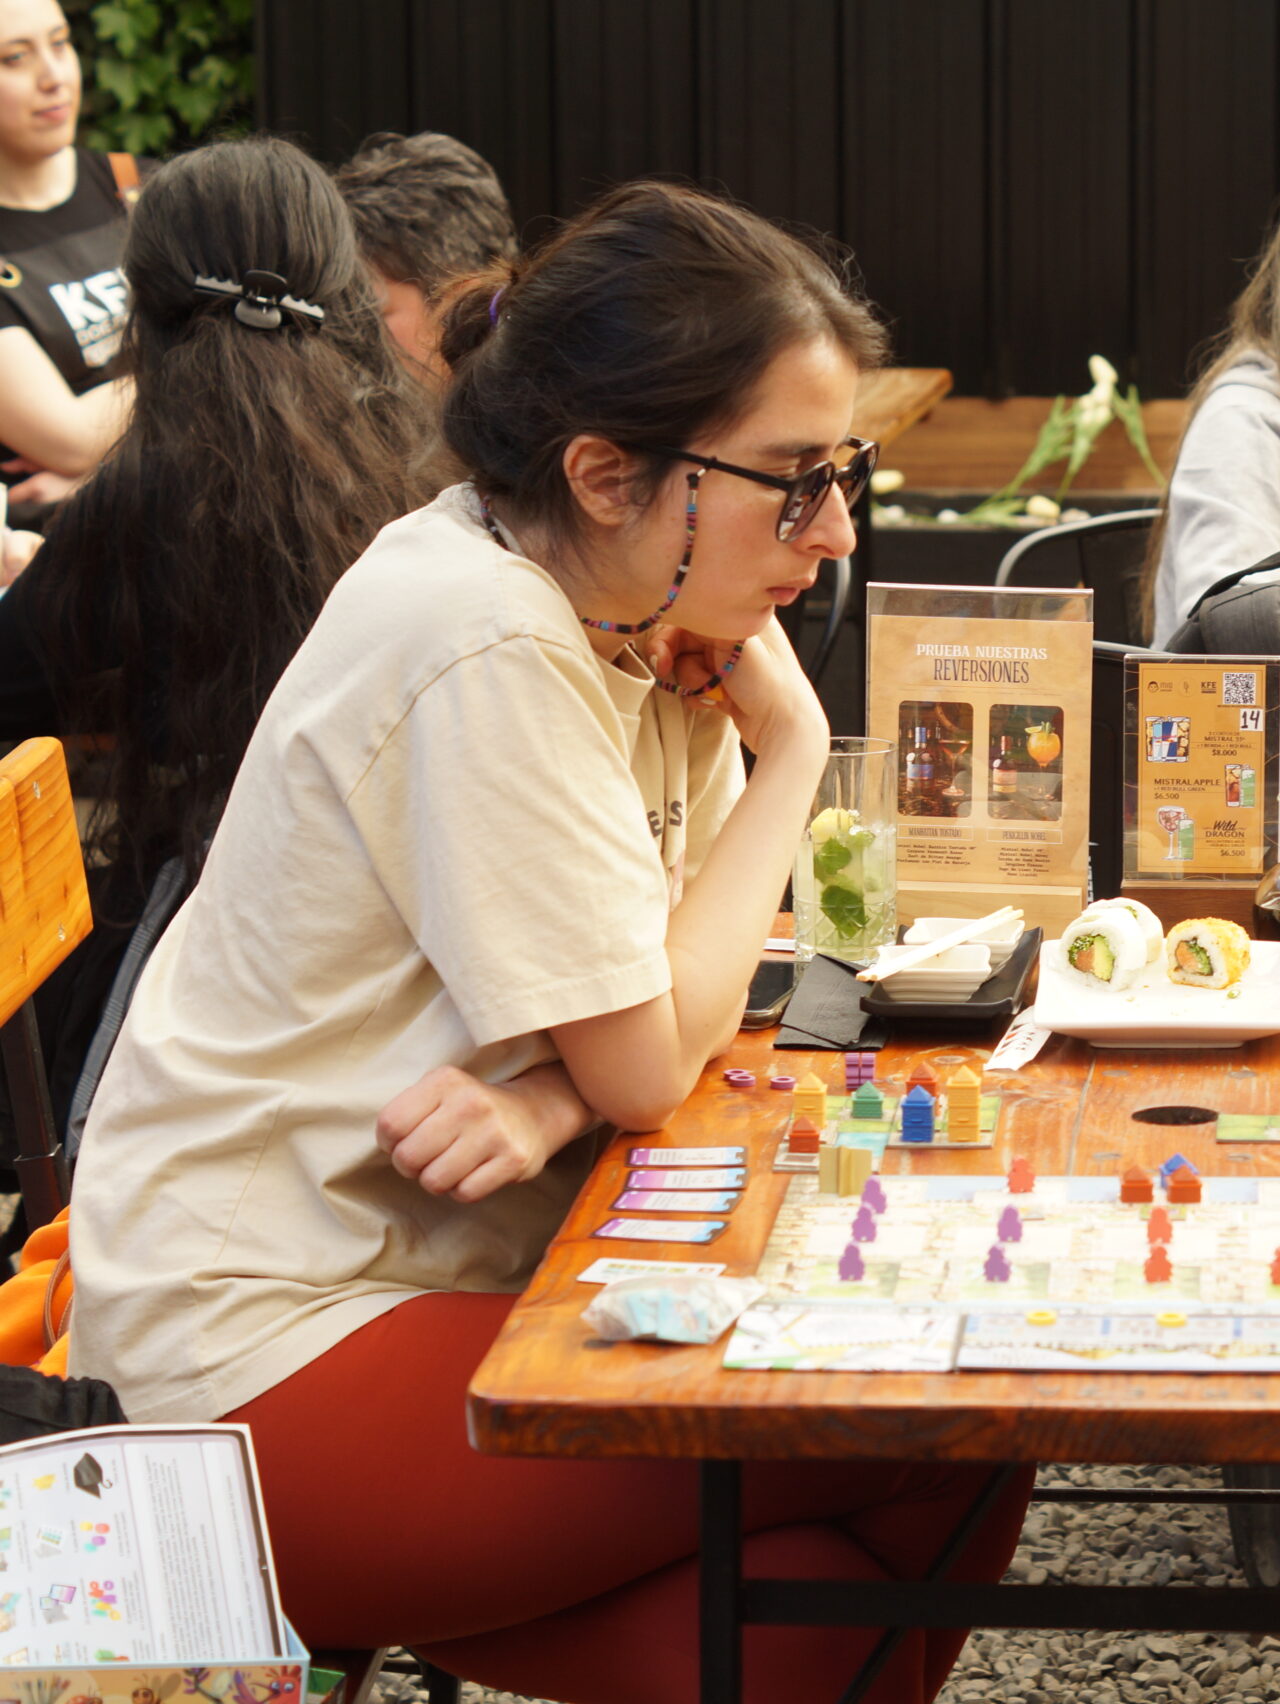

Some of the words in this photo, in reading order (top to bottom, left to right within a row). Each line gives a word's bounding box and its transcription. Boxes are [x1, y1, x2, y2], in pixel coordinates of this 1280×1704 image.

[48, 268, 128, 332] KF
[916, 643, 970, 657] PRUEBA
[975, 645, 1048, 660] NUESTRAS
[934, 658, 1030, 684] REVERSIONES
[1201, 681, 1217, 689] KFE
[1241, 710, 1261, 730] 14
[1212, 749, 1238, 757] $8.000
[1154, 778, 1191, 786] MISTRAL
[1194, 778, 1221, 786] APPLE
[1154, 792, 1180, 800] $6.500
[1213, 820, 1239, 831] Wild
[1220, 849, 1246, 857] $6.500
